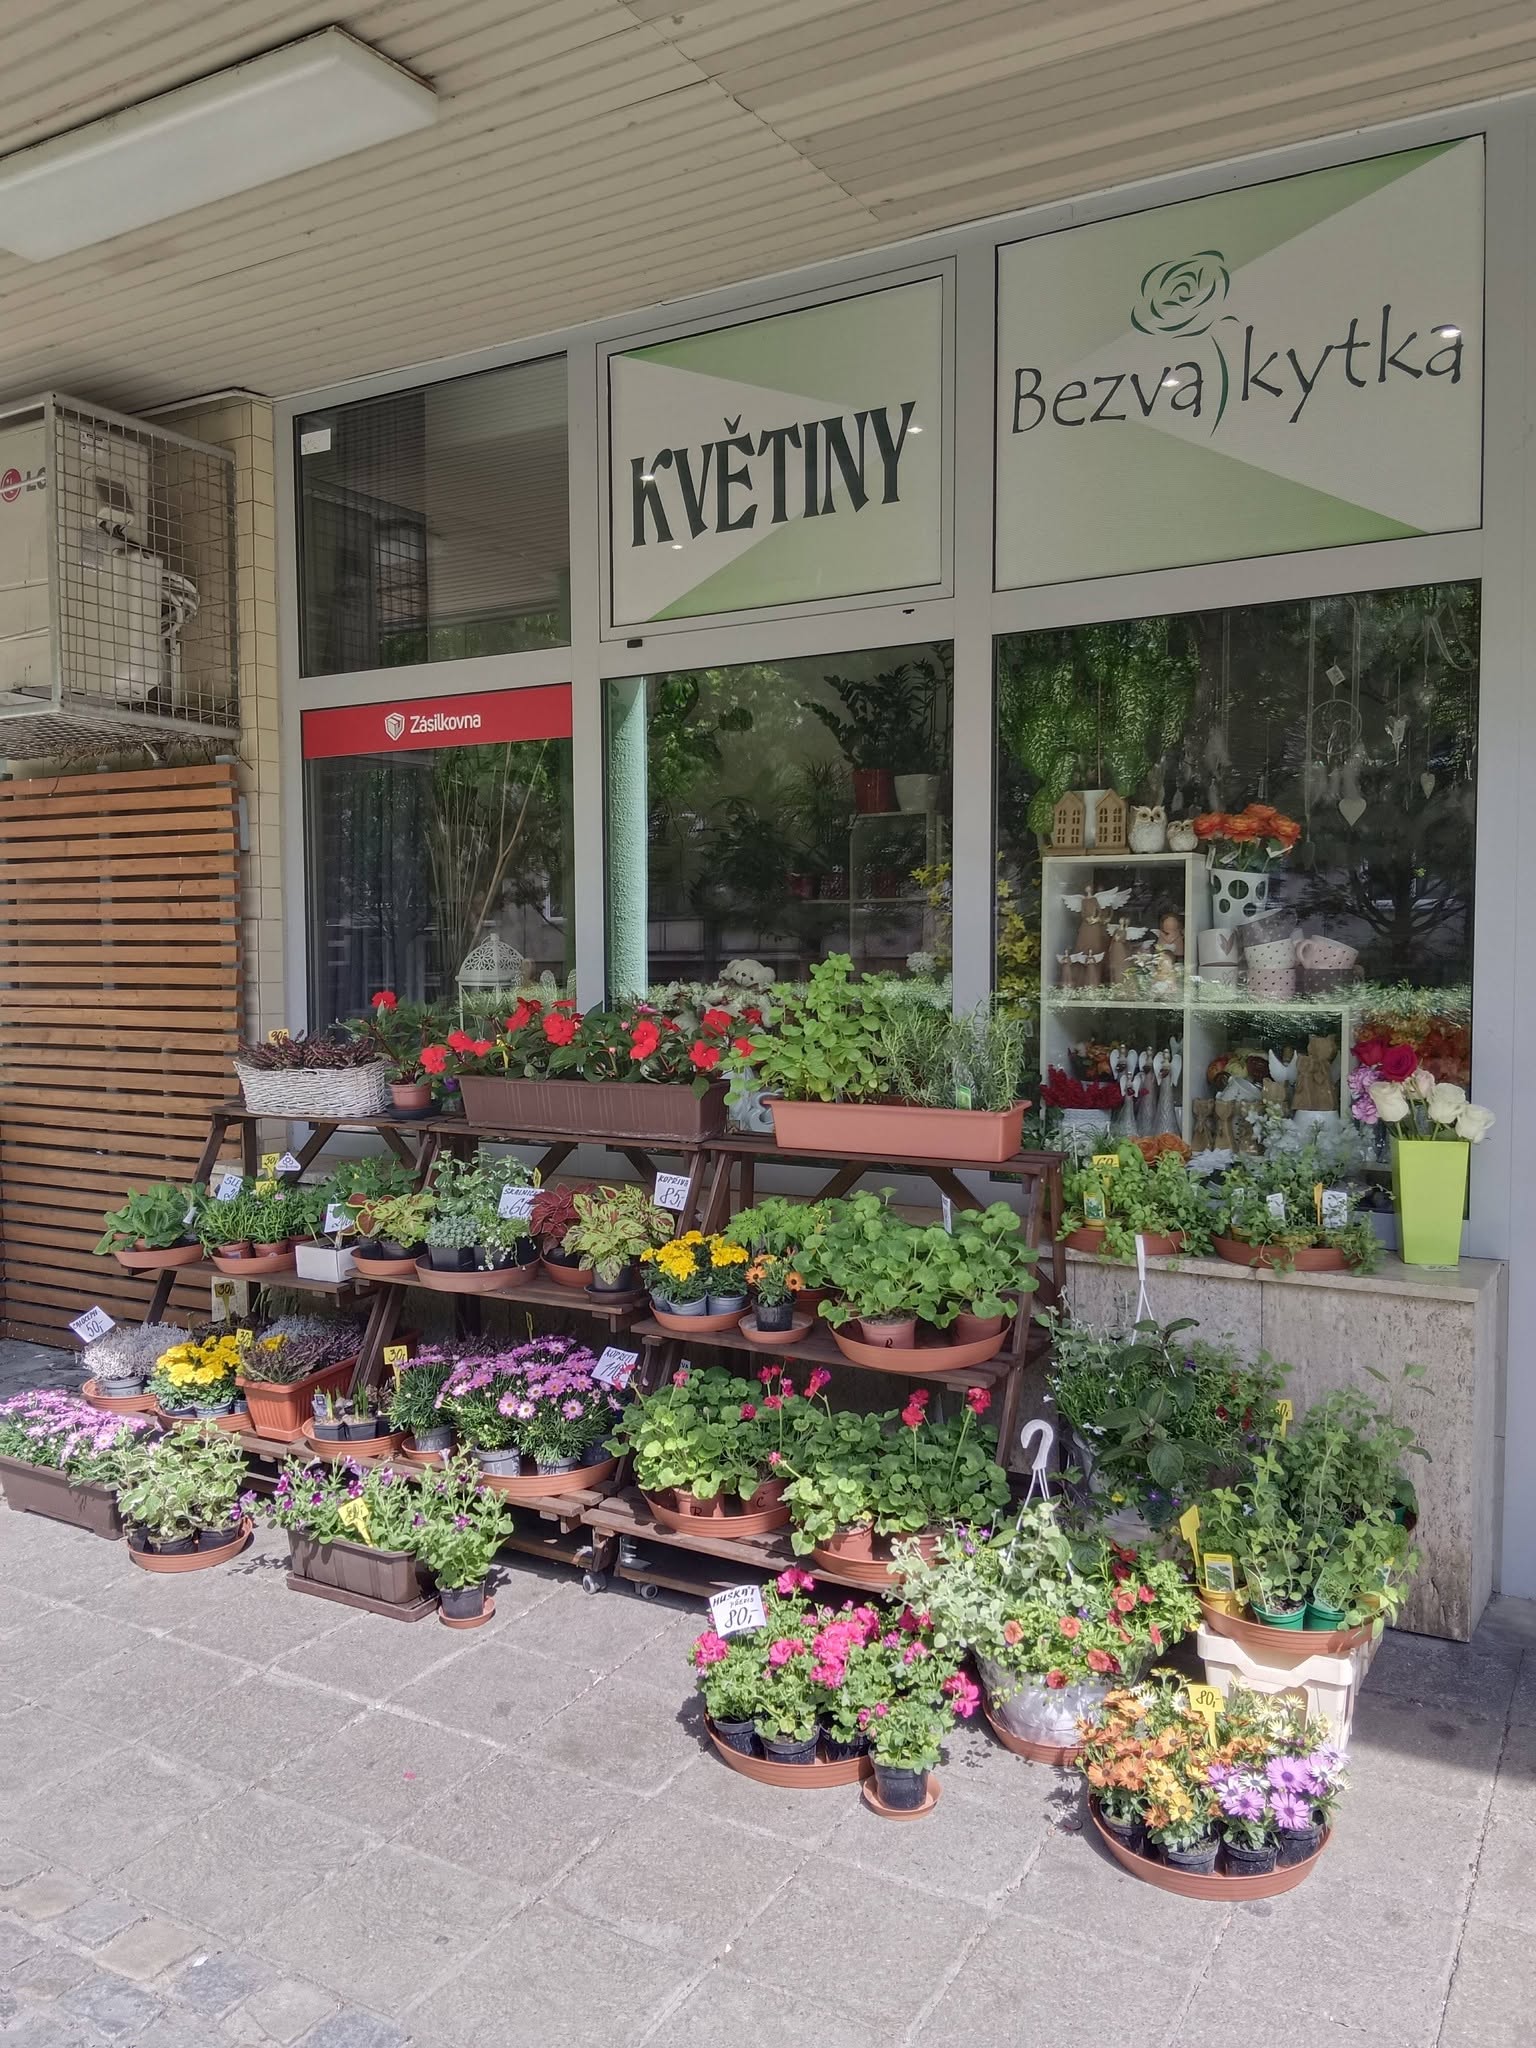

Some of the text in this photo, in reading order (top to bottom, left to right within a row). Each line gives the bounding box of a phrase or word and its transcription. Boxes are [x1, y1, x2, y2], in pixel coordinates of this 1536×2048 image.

[1012, 304, 1464, 434] Bezva kytka
[630, 400, 916, 547] KVĚTINY
[409, 713, 481, 734] Zásilkovna
